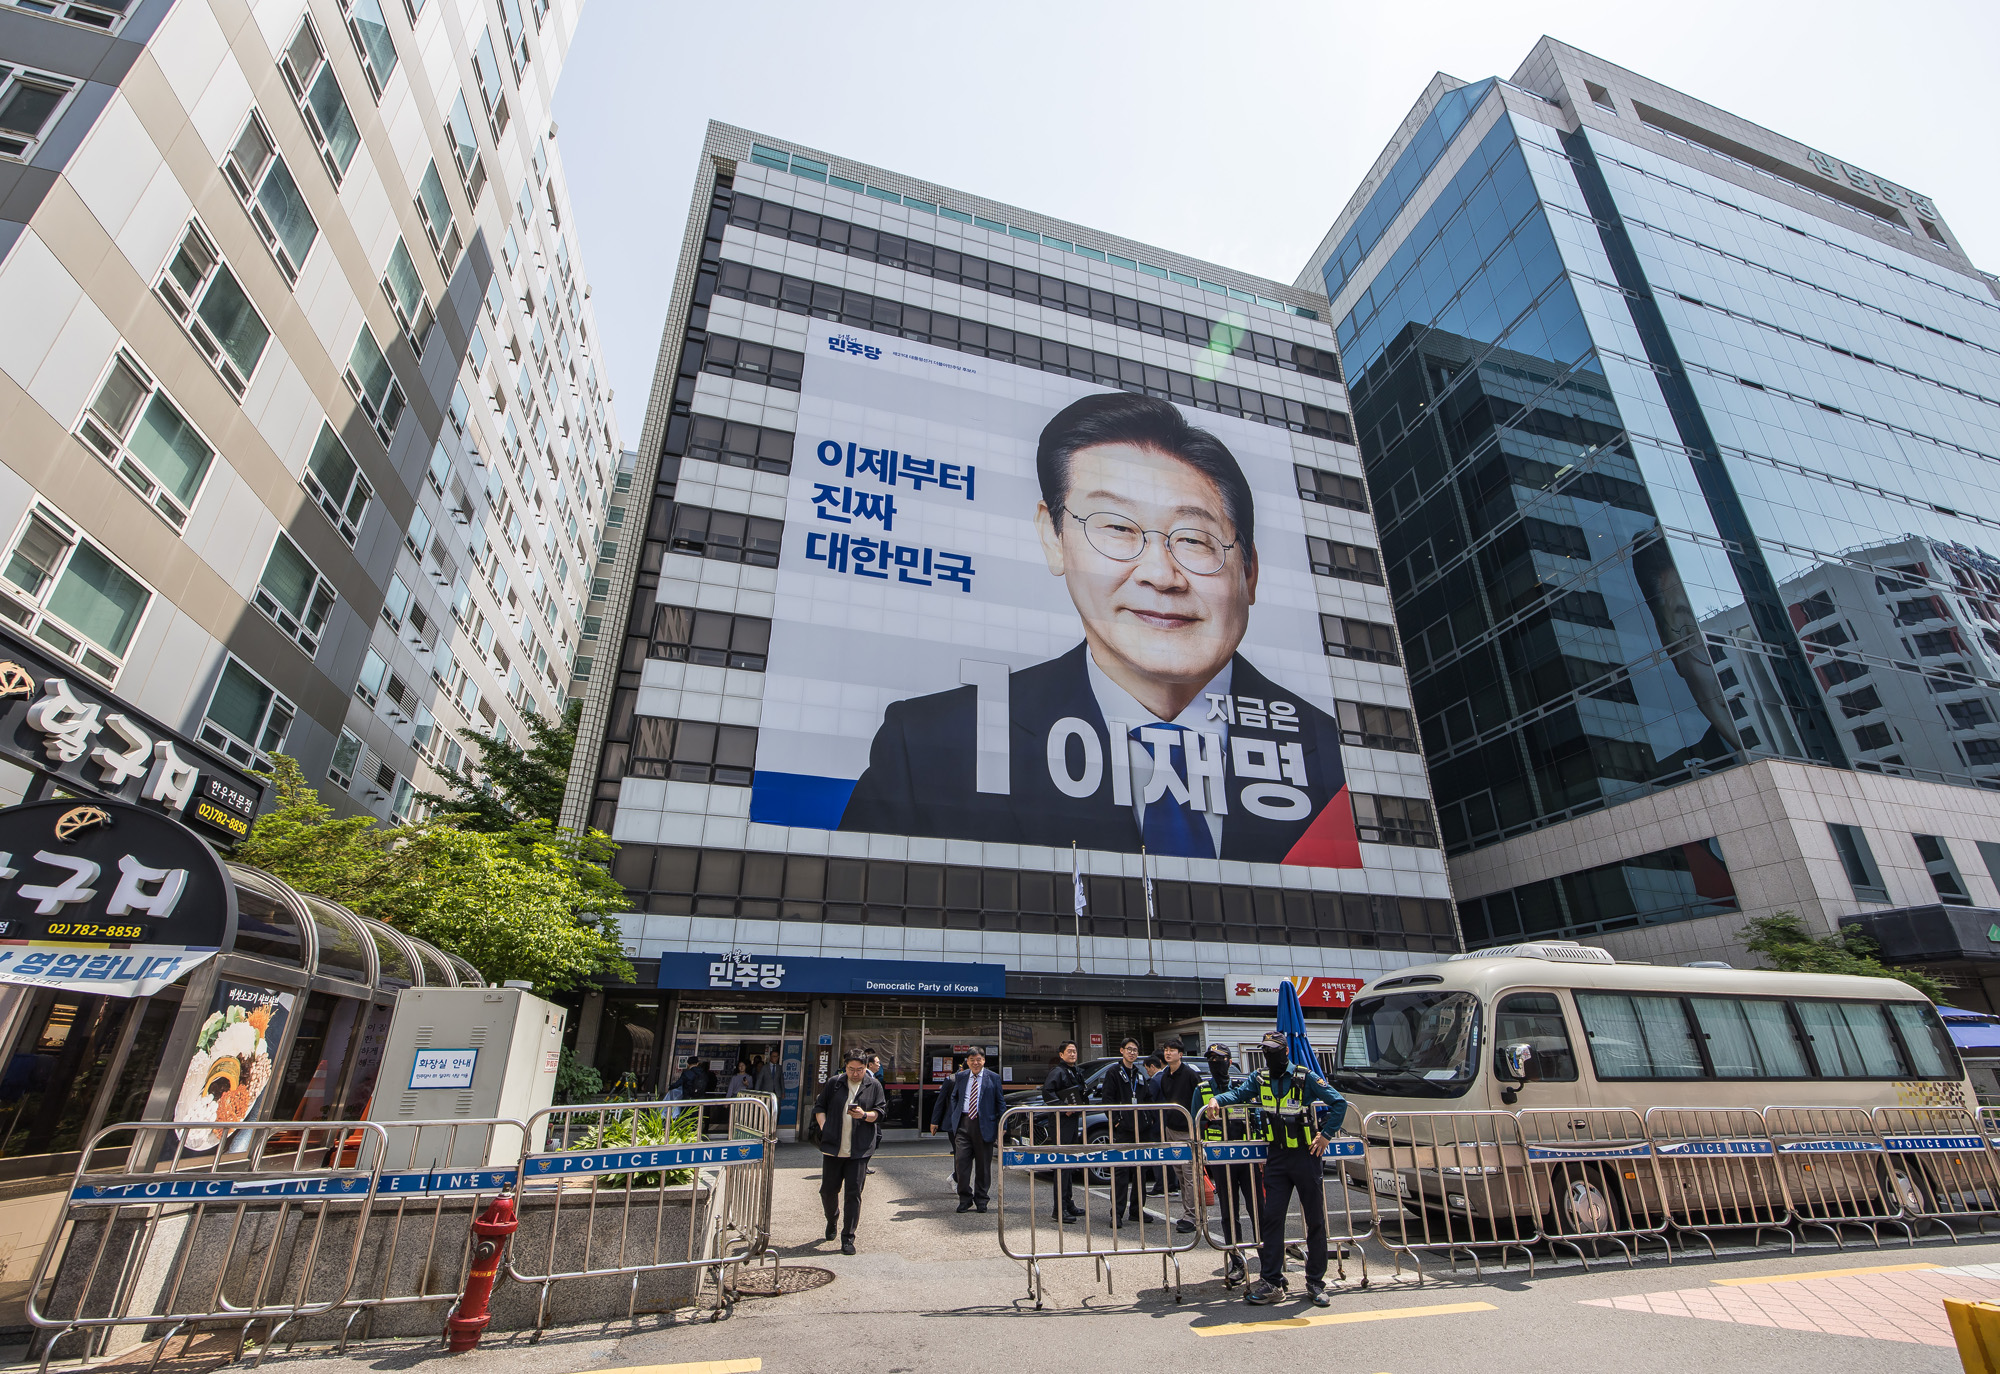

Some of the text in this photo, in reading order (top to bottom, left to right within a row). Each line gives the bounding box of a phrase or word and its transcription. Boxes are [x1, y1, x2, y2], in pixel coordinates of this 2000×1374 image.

[828, 337, 882, 360] 민주당
[817, 440, 975, 500] 이제부터
[810, 483, 897, 531] 진짜
[805, 532, 975, 593] 대한민국
[1204, 692, 1299, 733] 지금은
[959, 658, 1011, 795] 1
[27, 678, 200, 812] 달구지
[1046, 716, 1312, 821] 이재명
[211, 780, 253, 813] 한우전문점
[198, 803, 248, 834] 02)782-8858
[0, 849, 189, 918] 구지
[12, 952, 184, 981] 영업합니다
[721, 949, 752, 963] 더불어
[709, 962, 786, 989] 민주당
[866, 981, 979, 993] Democratic Party of Korea
[229, 988, 259, 1004] 버섯소고기
[419, 1058, 471, 1069] 화장실 안내
[818, 1054, 829, 1084] 민주당
[1122, 1149, 1165, 1160] LINE
[1730, 1143, 1757, 1152] LINE
[1842, 1141, 1867, 1150] LINE
[1898, 1138, 1973, 1149] POLICE LINE
[563, 1148, 728, 1171] POLICE LINE
[123, 1181, 238, 1197] POLICE
[419, 1173, 479, 1190] LINE
